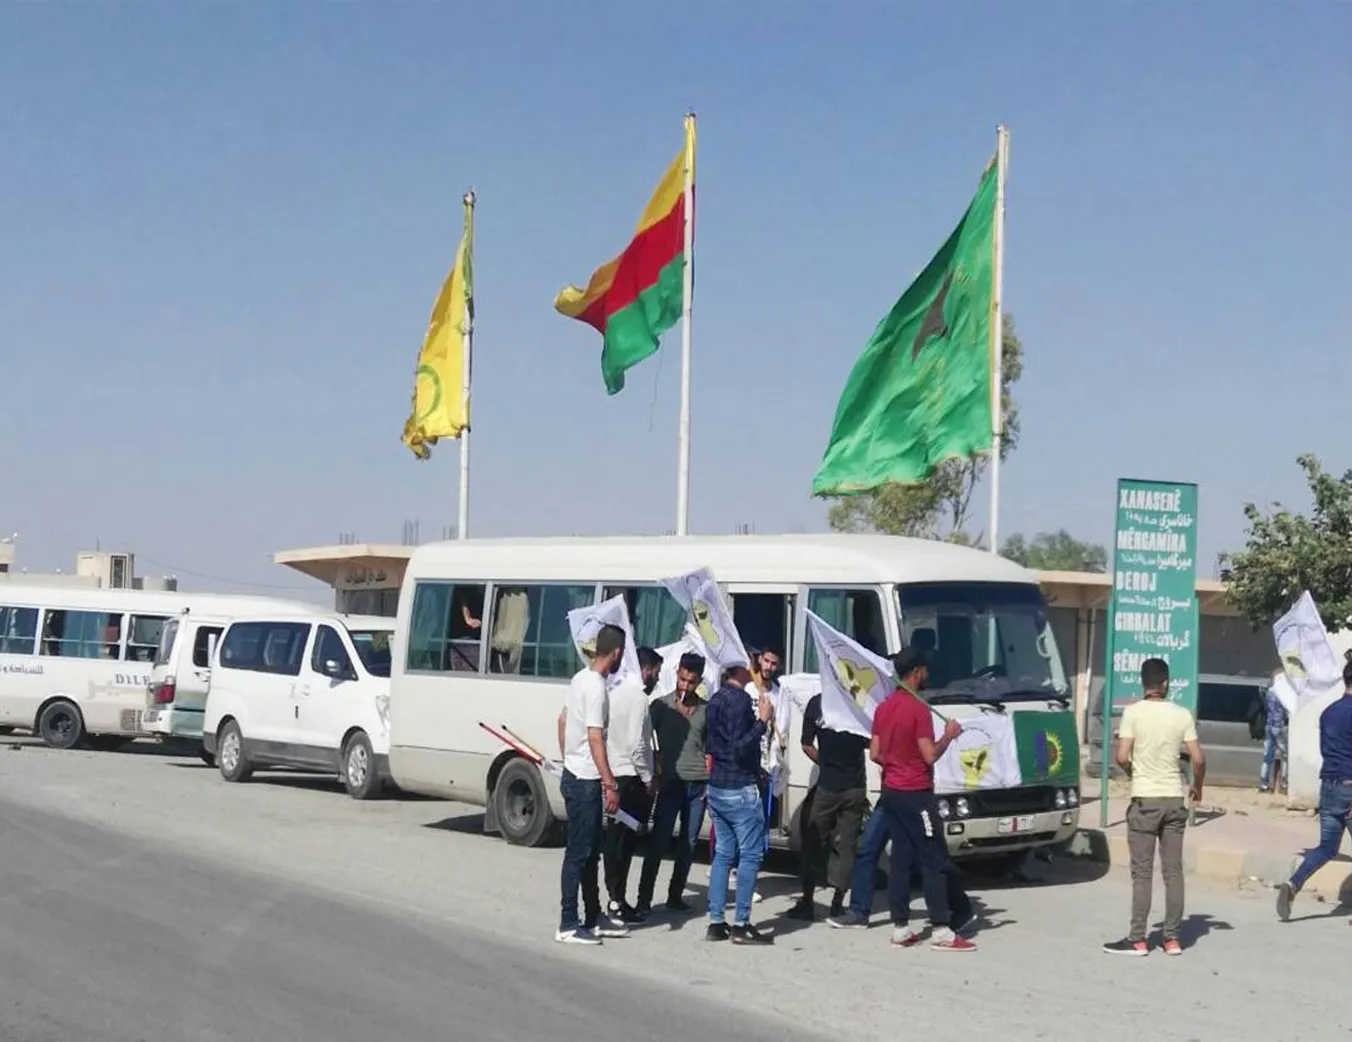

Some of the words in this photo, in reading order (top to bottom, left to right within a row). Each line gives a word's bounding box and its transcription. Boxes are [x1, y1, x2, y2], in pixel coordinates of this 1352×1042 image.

[1120, 488, 1181, 512] XANASERÊ
[1117, 527, 1187, 552] MÊRGAMÎRA
[1116, 571, 1157, 592] BEROJ
